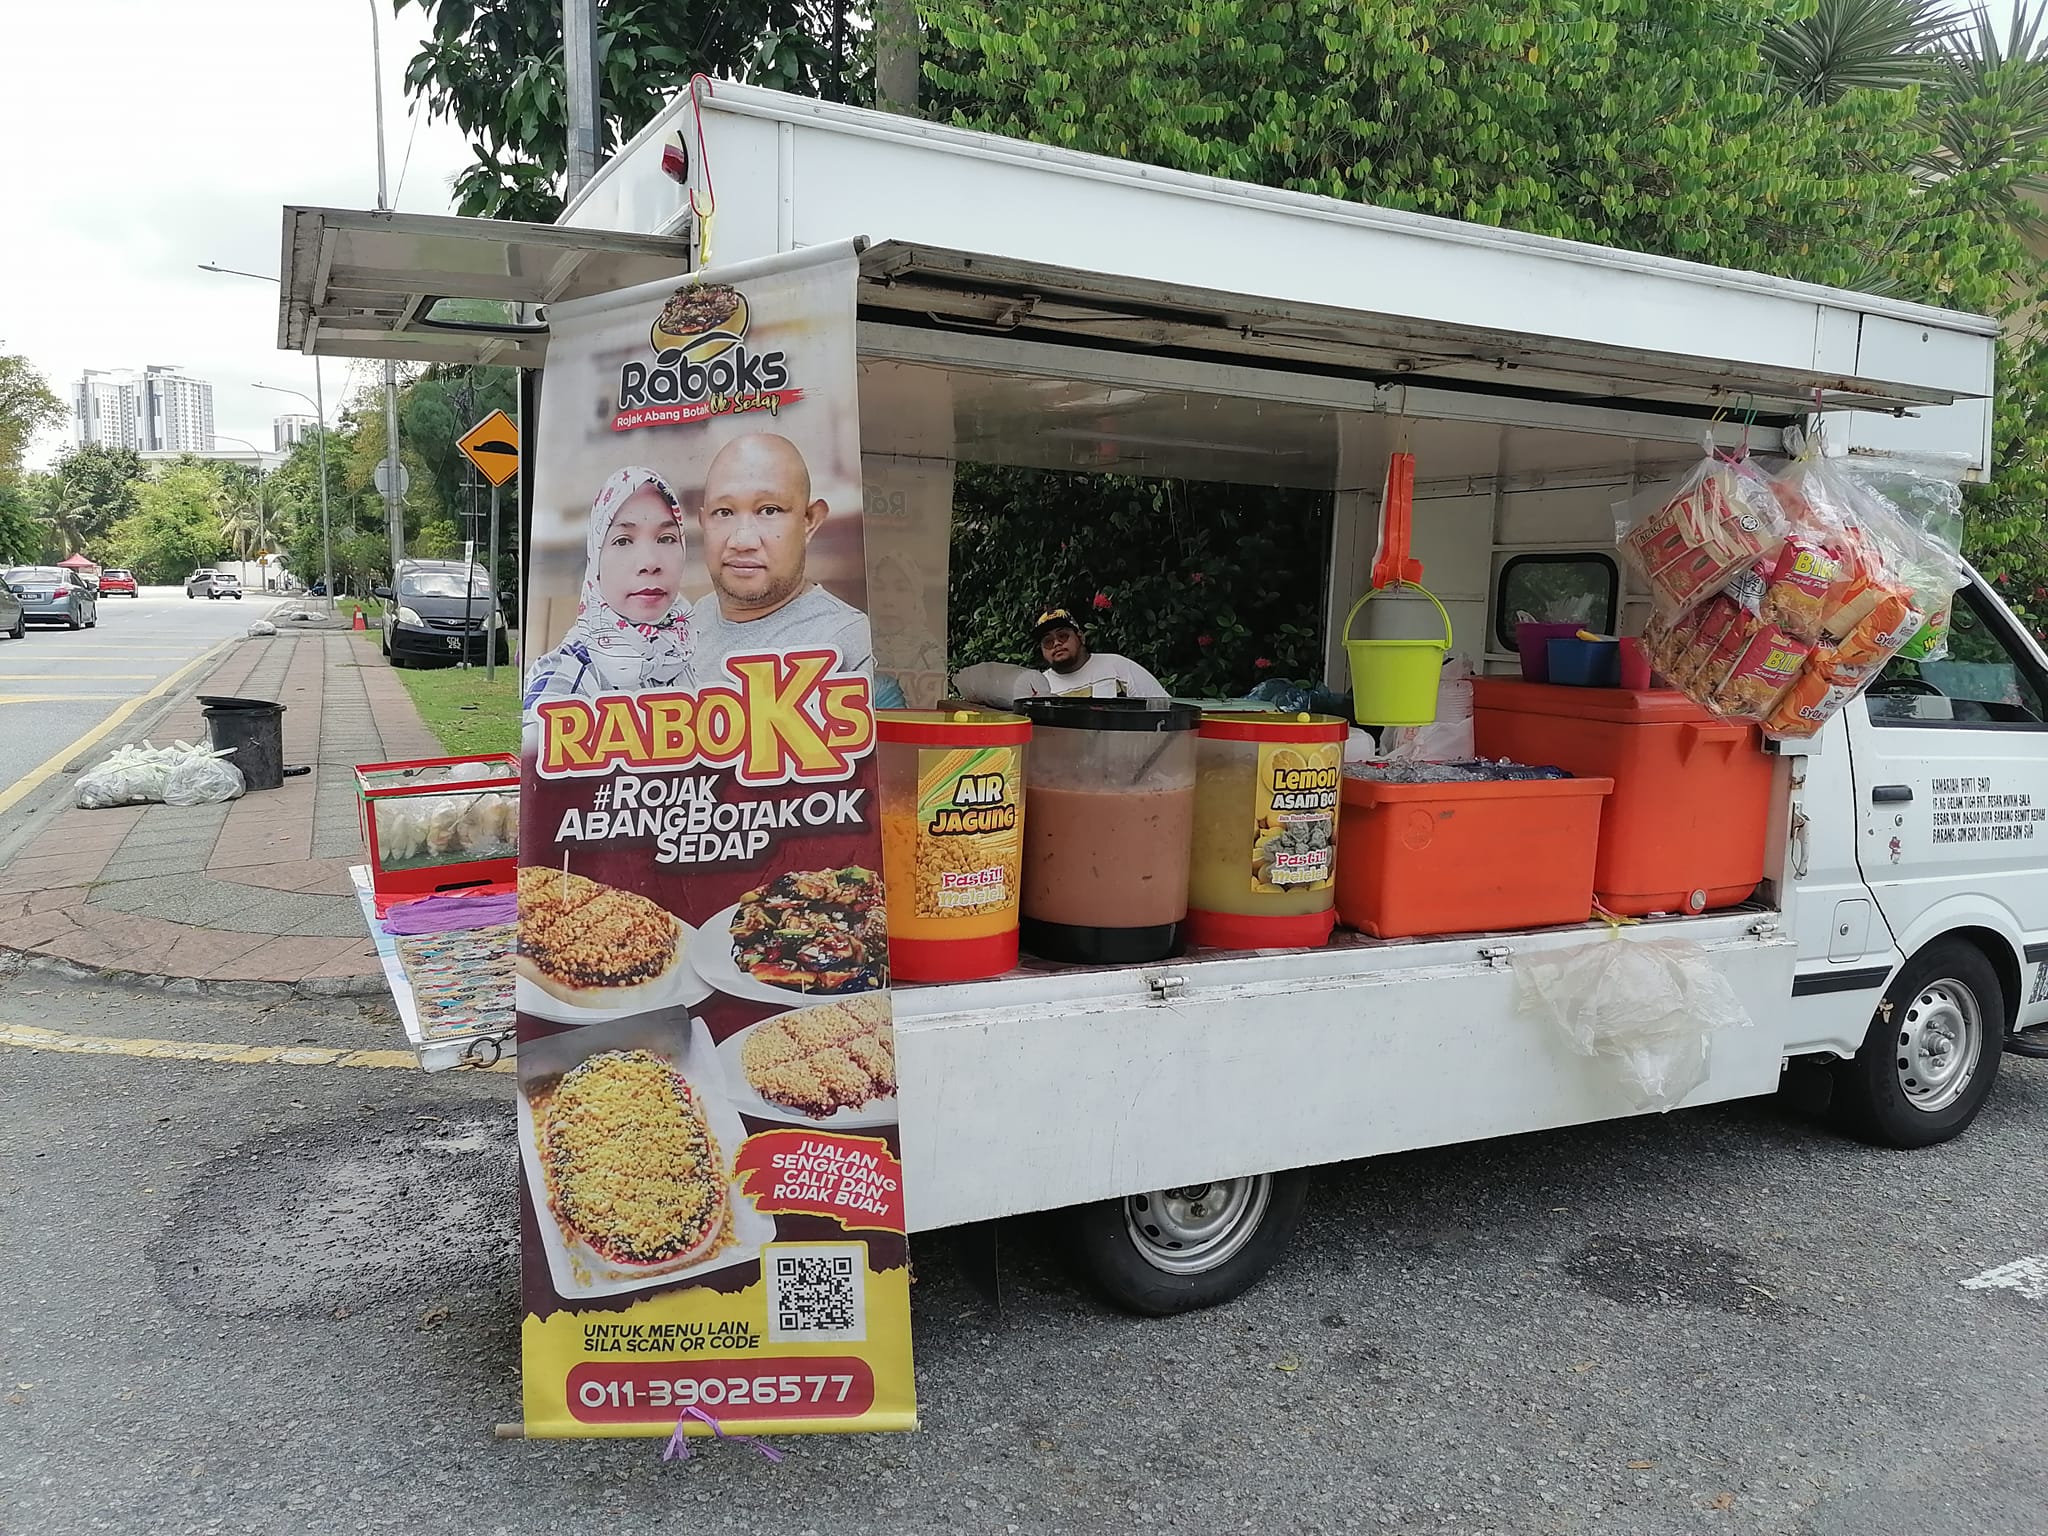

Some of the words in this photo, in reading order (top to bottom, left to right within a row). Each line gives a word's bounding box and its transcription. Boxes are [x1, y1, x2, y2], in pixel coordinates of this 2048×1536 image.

[617, 413, 642, 428] Rojak
[644, 410, 680, 424] Abang
[683, 406, 710, 419] Botak
[594, 774, 720, 811] #ROJAK
[953, 773, 1004, 806] AIR
[1271, 792, 1319, 811] ASAM
[929, 805, 1015, 836] JAGUNG
[655, 830, 770, 864] SEDAP
[797, 1140, 878, 1169] JUALAN
[771, 1153, 897, 1192] SENGKUANG
[783, 1169, 838, 1188] CALIT
[840, 1178, 883, 1200] DAN
[773, 1184, 833, 1202] ROJAK
[834, 1191, 889, 1216] BUAH
[584, 1323, 644, 1338] UNTUK
[648, 1322, 703, 1338] MENU
[707, 1321, 749, 1336] LAIN
[584, 1338, 622, 1352] SILA
[626, 1338, 675, 1352] SCAN
[709, 1335, 760, 1349] CODE
[579, 1374, 854, 1407] 011-39026577
